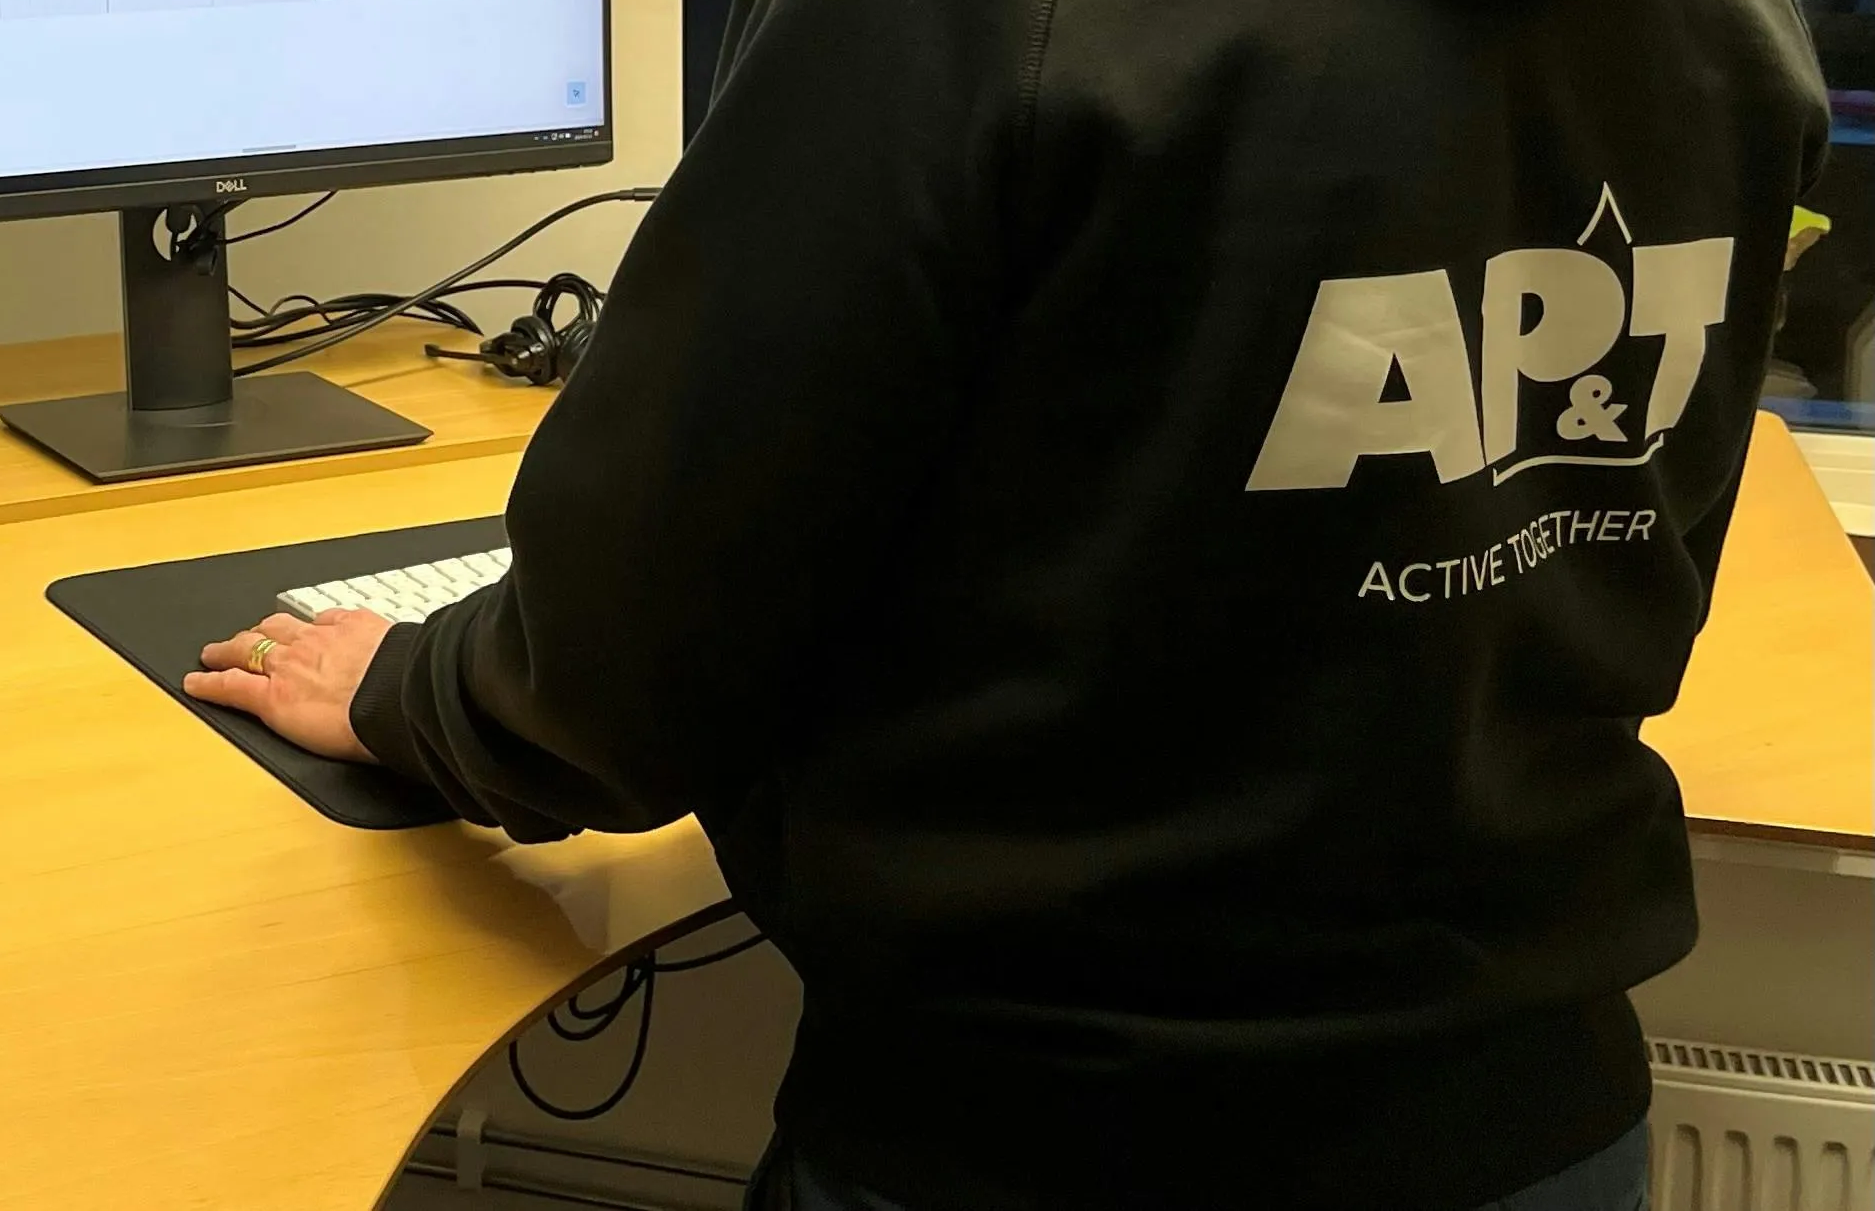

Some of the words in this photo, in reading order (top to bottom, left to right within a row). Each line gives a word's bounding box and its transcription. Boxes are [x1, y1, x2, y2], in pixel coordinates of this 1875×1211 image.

[216, 179, 247, 193] DELL
[1245, 237, 1734, 491] AP&T
[1357, 543, 1505, 603] ACTIVE
[1507, 509, 1657, 574] TOGETHER
